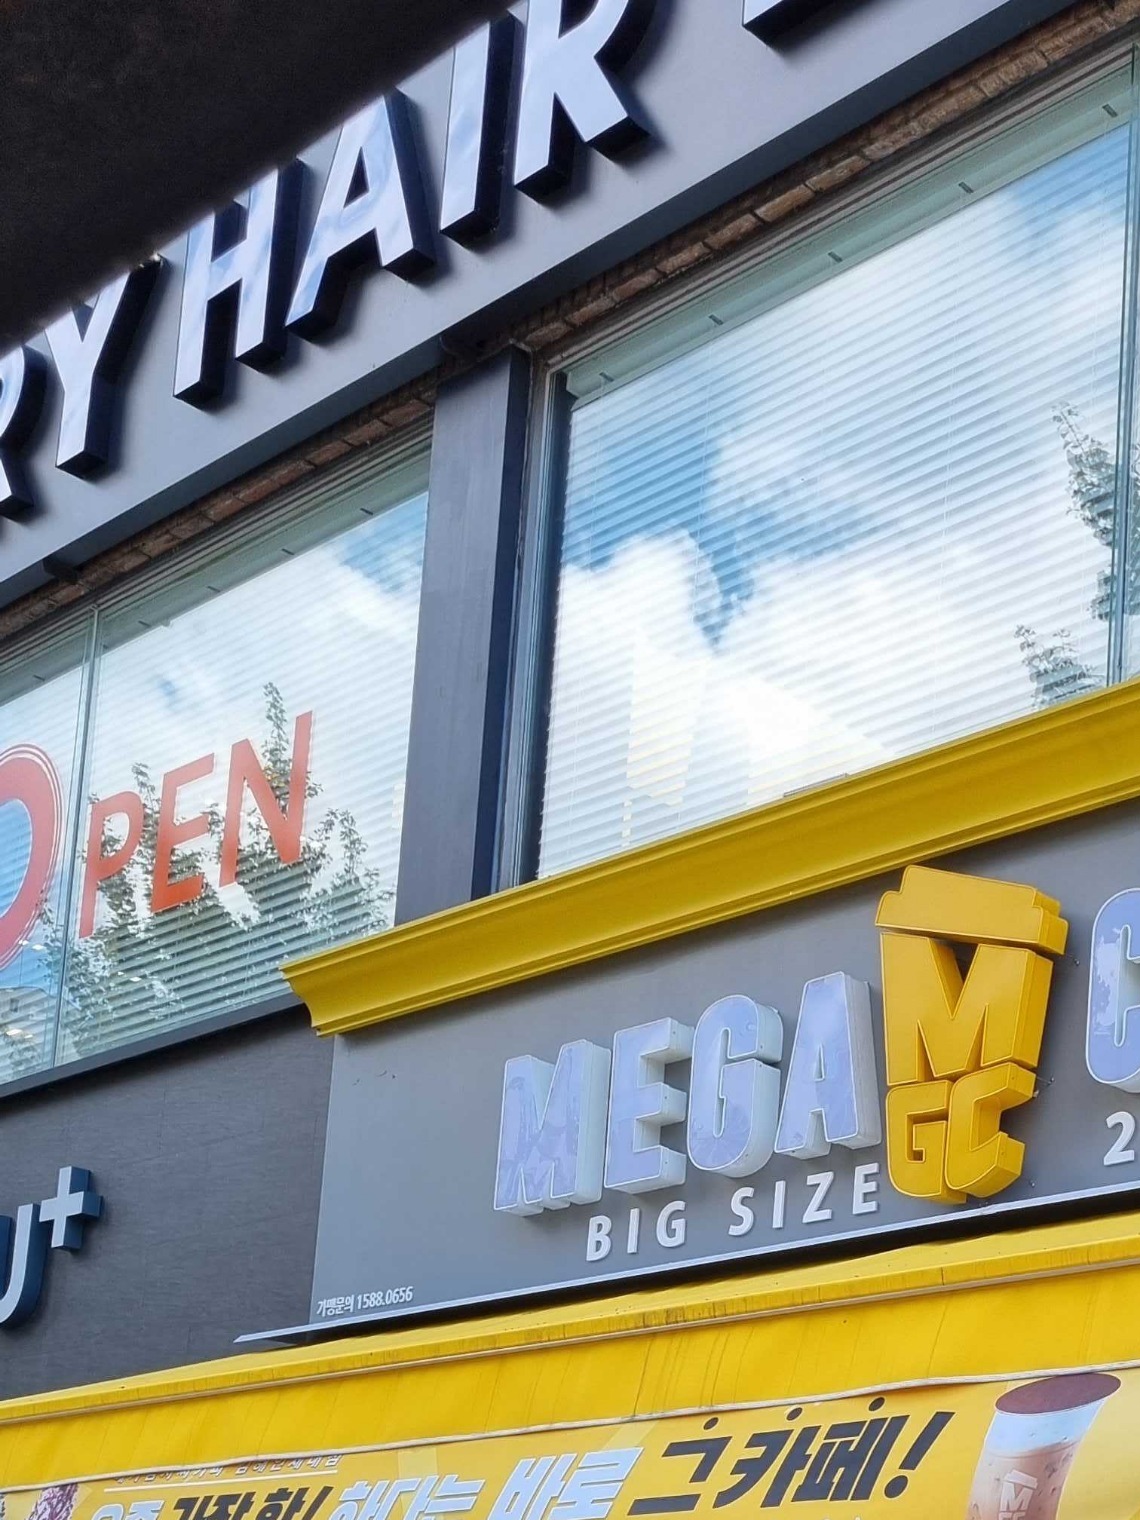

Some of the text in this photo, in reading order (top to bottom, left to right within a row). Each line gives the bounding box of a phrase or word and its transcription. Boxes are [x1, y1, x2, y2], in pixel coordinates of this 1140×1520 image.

[174, 0, 645, 400] HAIR
[494, 972, 882, 1217] MEGA
[1103, 1110, 1137, 1167] 2
[586, 1162, 881, 1262] BIG SIZE
[316, 1285, 414, 1317] 가맹문의 1588.0656
